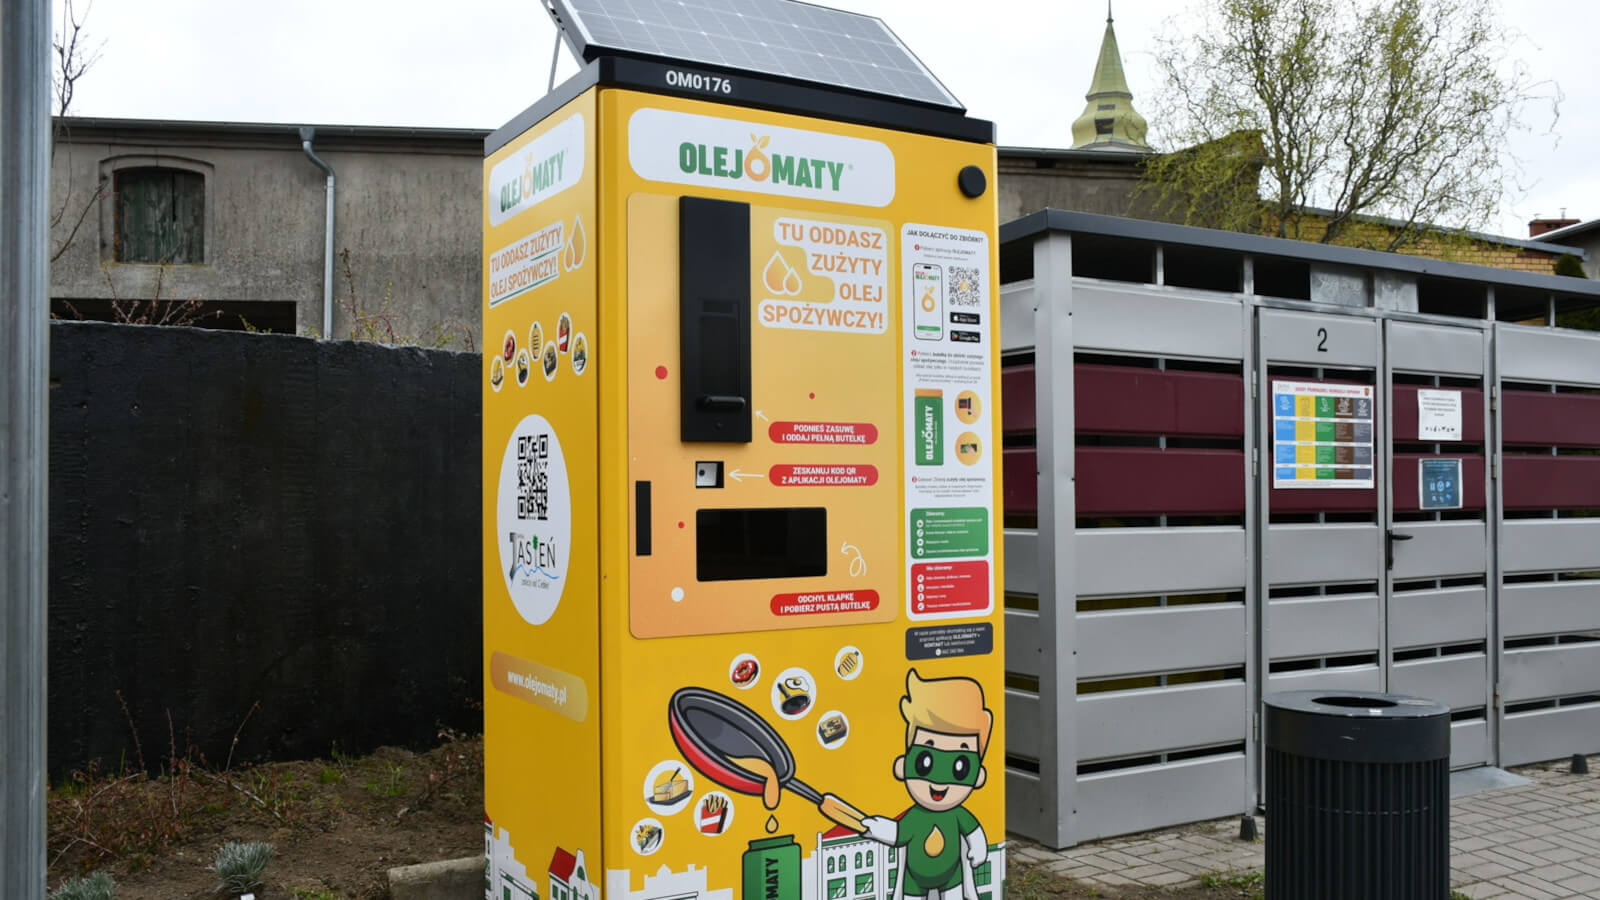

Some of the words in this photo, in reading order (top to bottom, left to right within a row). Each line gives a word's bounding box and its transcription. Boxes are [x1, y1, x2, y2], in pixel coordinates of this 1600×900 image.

[666, 70, 732, 94] OM0176
[679, 133, 844, 192] OLEJOMATY
[500, 150, 565, 213] OLEJOMATY
[779, 222, 804, 242] TU
[809, 226, 883, 250] ODDASZ
[919, 231, 949, 240] DOŁĄCZYĆ
[491, 257, 500, 273] TU
[501, 240, 529, 269] ODDASZ
[530, 227, 562, 256] ZUŻYTY
[490, 278, 507, 298] OLEJ
[508, 255, 557, 291] SPOŻYWCZY!
[811, 252, 883, 276] ZUŻYTY
[839, 282, 883, 303] OLEJ
[763, 303, 884, 329] SPOŻYWCZY!
[1316, 327, 1328, 352] 2
[794, 424, 824, 433] PODNIEŚ
[825, 425, 855, 434] ZASUWĘ
[811, 434, 835, 443] PEŁNĄ
[835, 435, 866, 443] BUTELKĘ
[921, 405, 934, 460] OLEJOMATY
[781, 476, 787, 484] Z
[788, 476, 825, 484] APLIKACJI
[825, 476, 867, 484] OLEJOMATY
[792, 467, 830, 475] ZESKANUJ
[831, 467, 846, 475] KOD
[846, 467, 856, 475] QR
[509, 532, 556, 581] JASIEŃ
[784, 604, 815, 614] POBIERZ
[816, 603, 839, 613] PUSTĄ
[840, 601, 871, 611] BUTELKĘ
[797, 594, 826, 604] ODCHYL
[507, 669, 567, 705] www.olejomaty.pl
[765, 857, 779, 899] MATY
